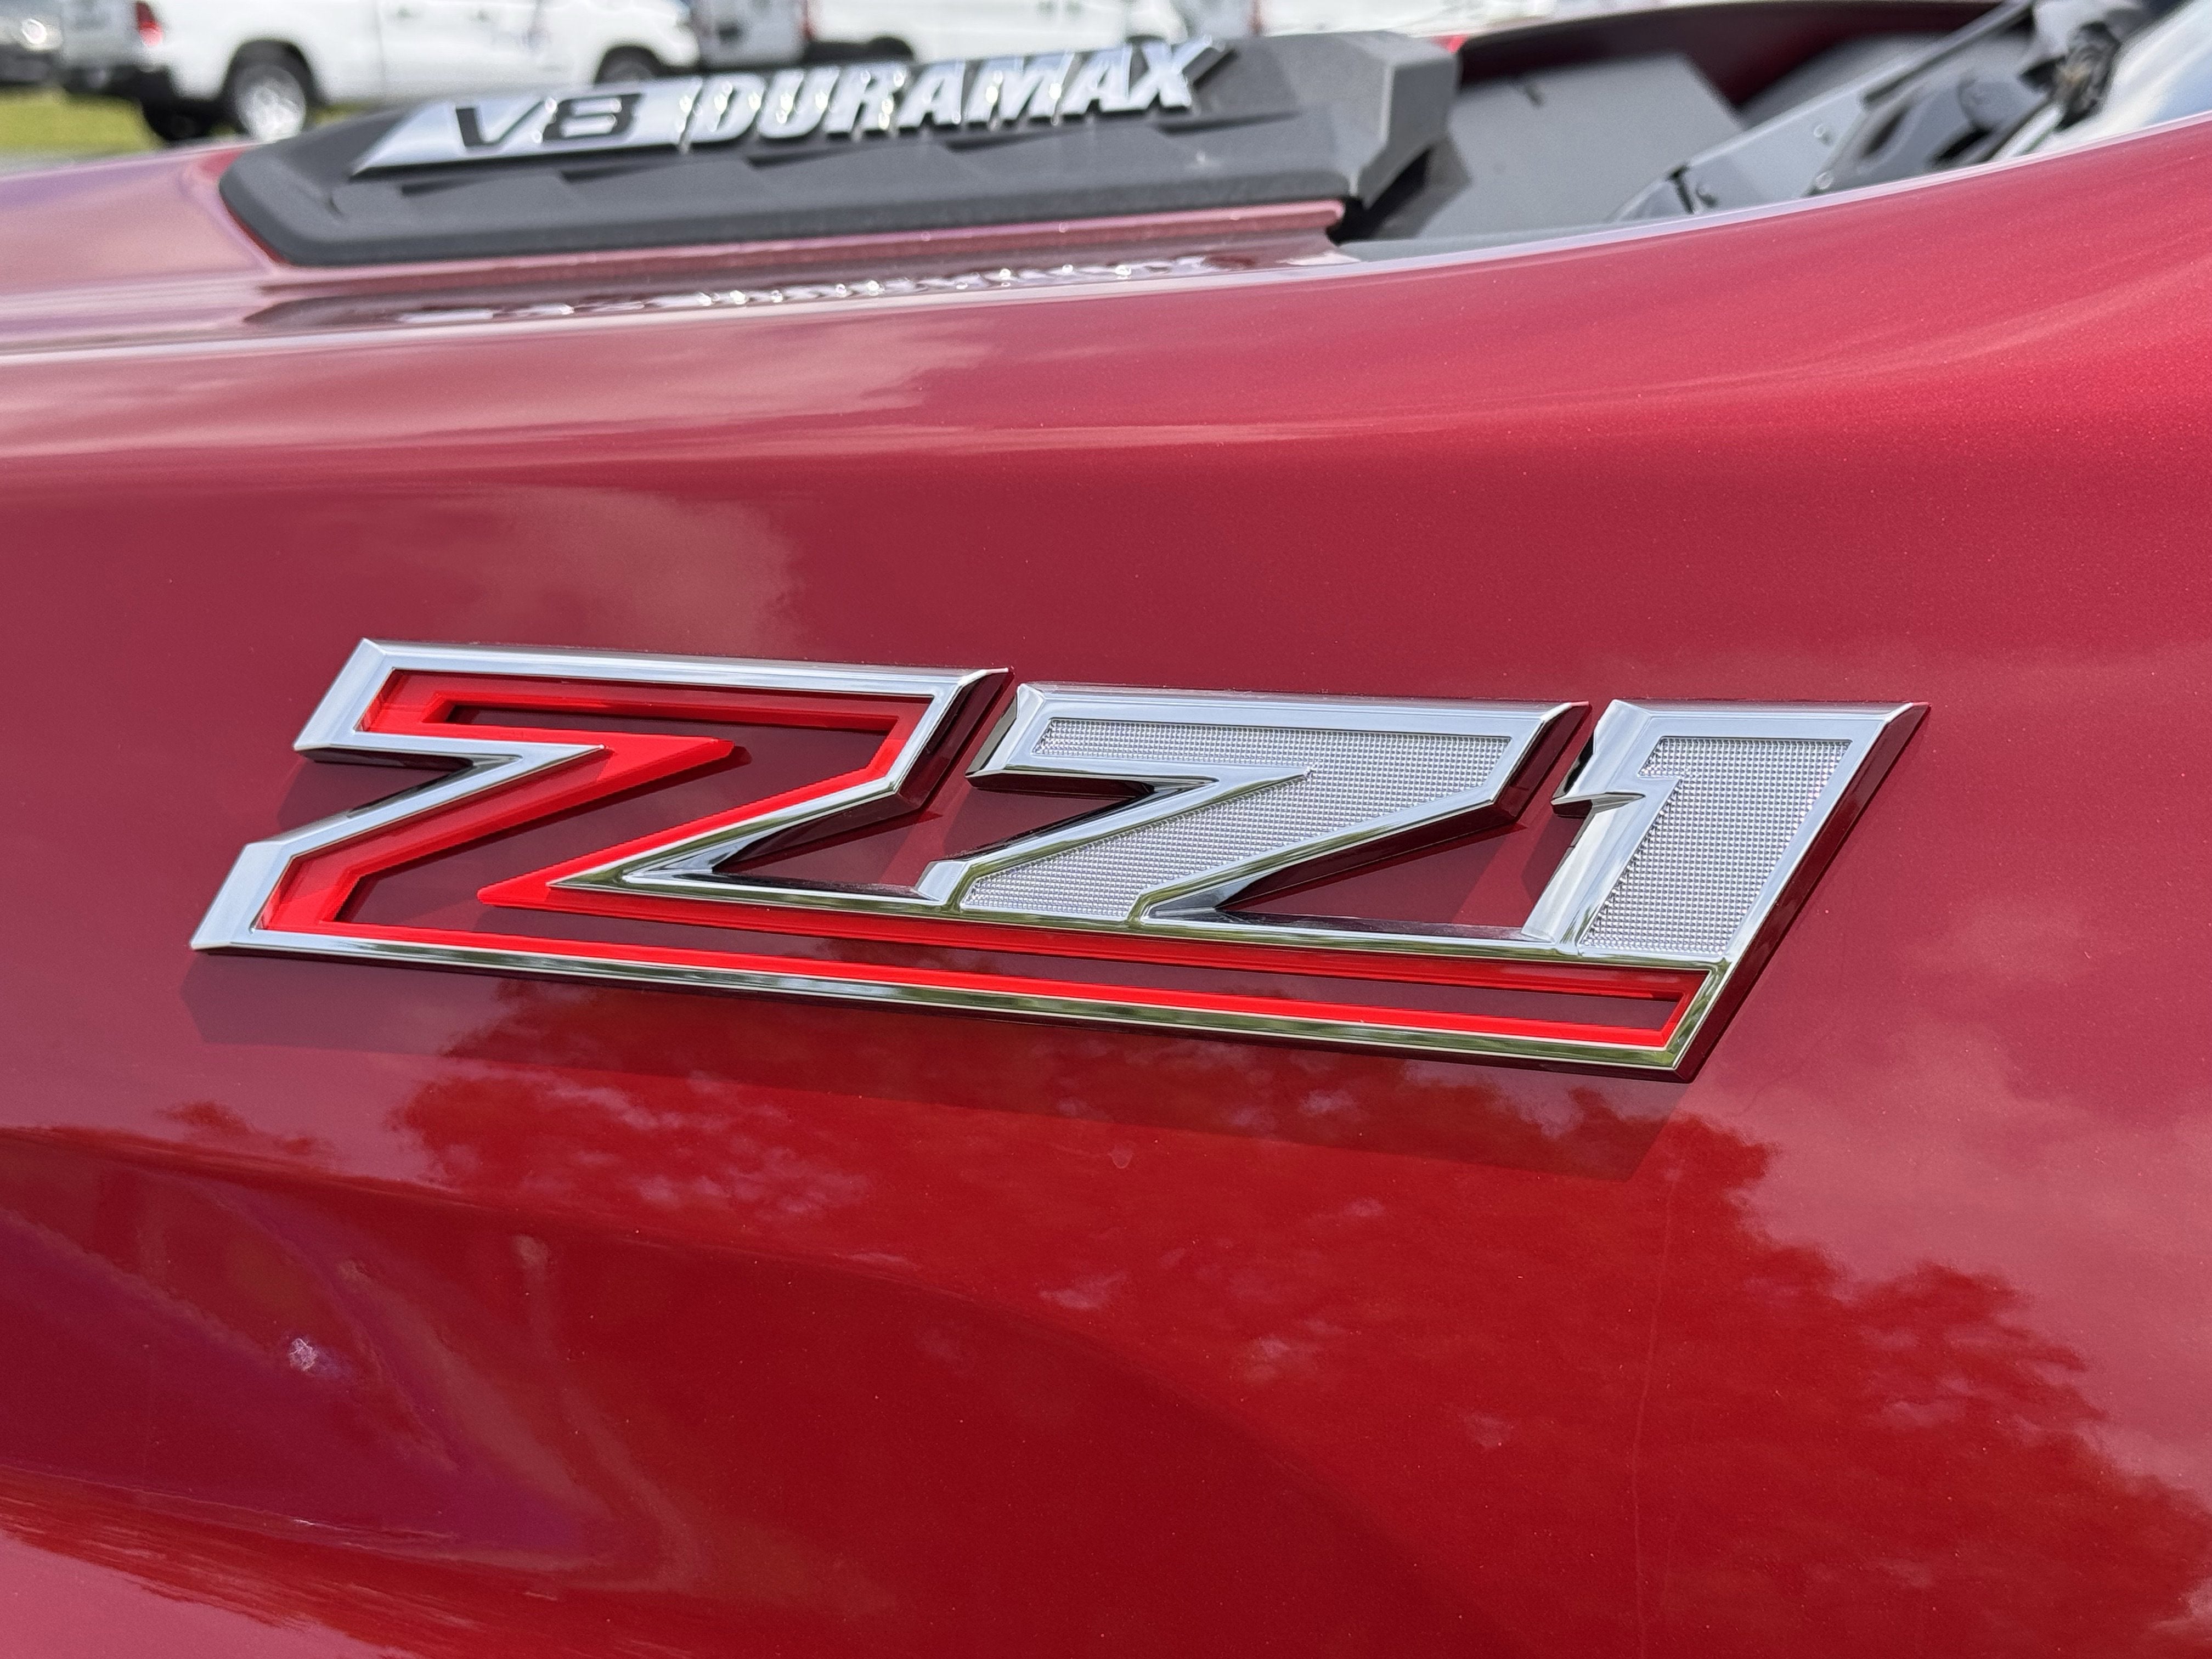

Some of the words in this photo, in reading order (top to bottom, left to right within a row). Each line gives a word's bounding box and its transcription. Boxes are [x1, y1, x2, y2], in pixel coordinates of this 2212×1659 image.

[455, 92, 643, 149] V8
[684, 35, 1215, 146] DURAMAX
[190, 638, 1928, 1082] Z71
